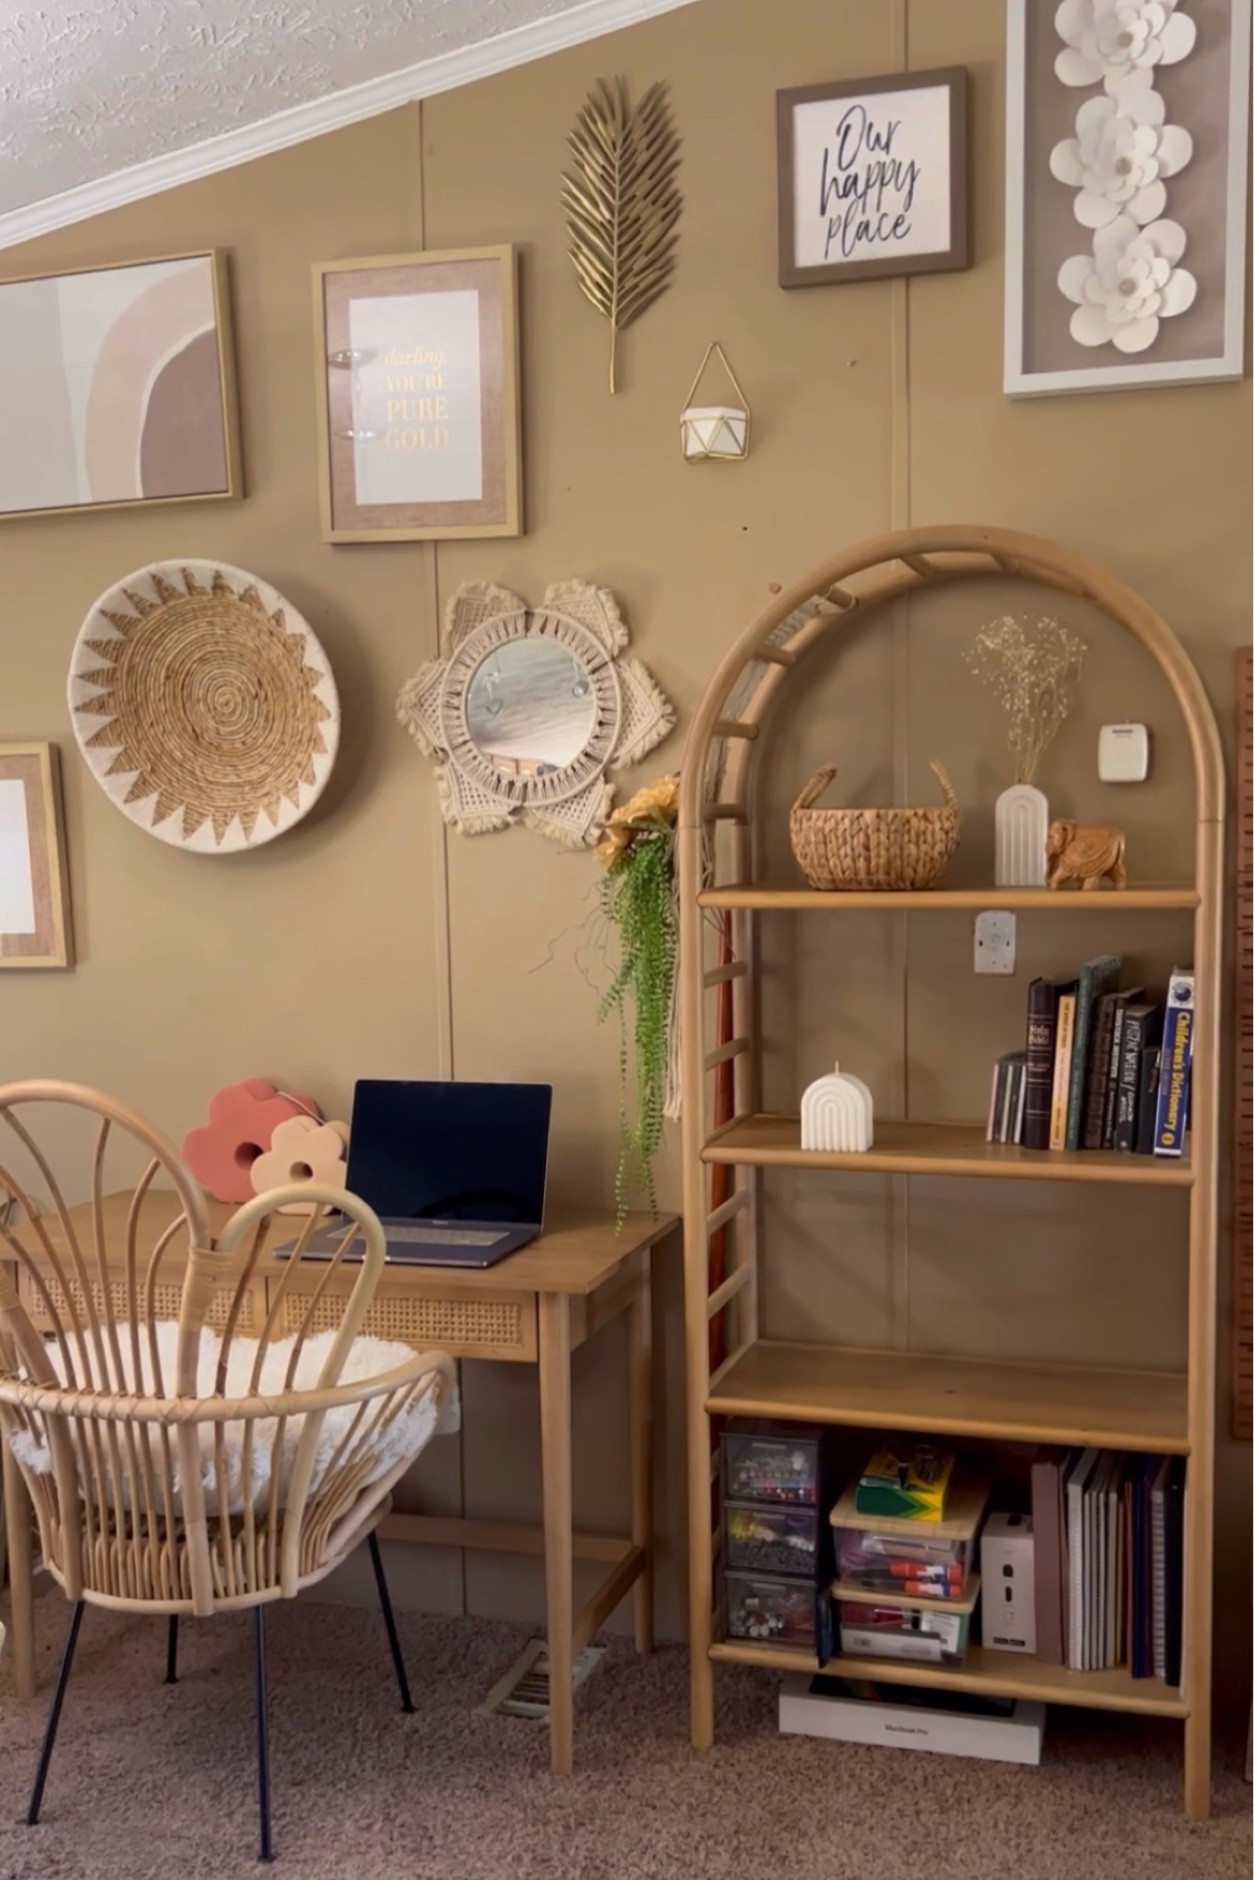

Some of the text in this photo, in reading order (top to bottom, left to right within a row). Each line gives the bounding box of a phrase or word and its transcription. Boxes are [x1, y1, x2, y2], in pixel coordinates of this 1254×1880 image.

[836, 104, 901, 172] Our
[819, 147, 921, 217] happy
[824, 198, 912, 260] place
[384, 346, 445, 372] darling
[385, 426, 449, 449] GOLD
[387, 397, 447, 422] PURE
[1172, 1011, 1190, 1070] Children's
[1164, 1072, 1184, 1131] Dictionary
